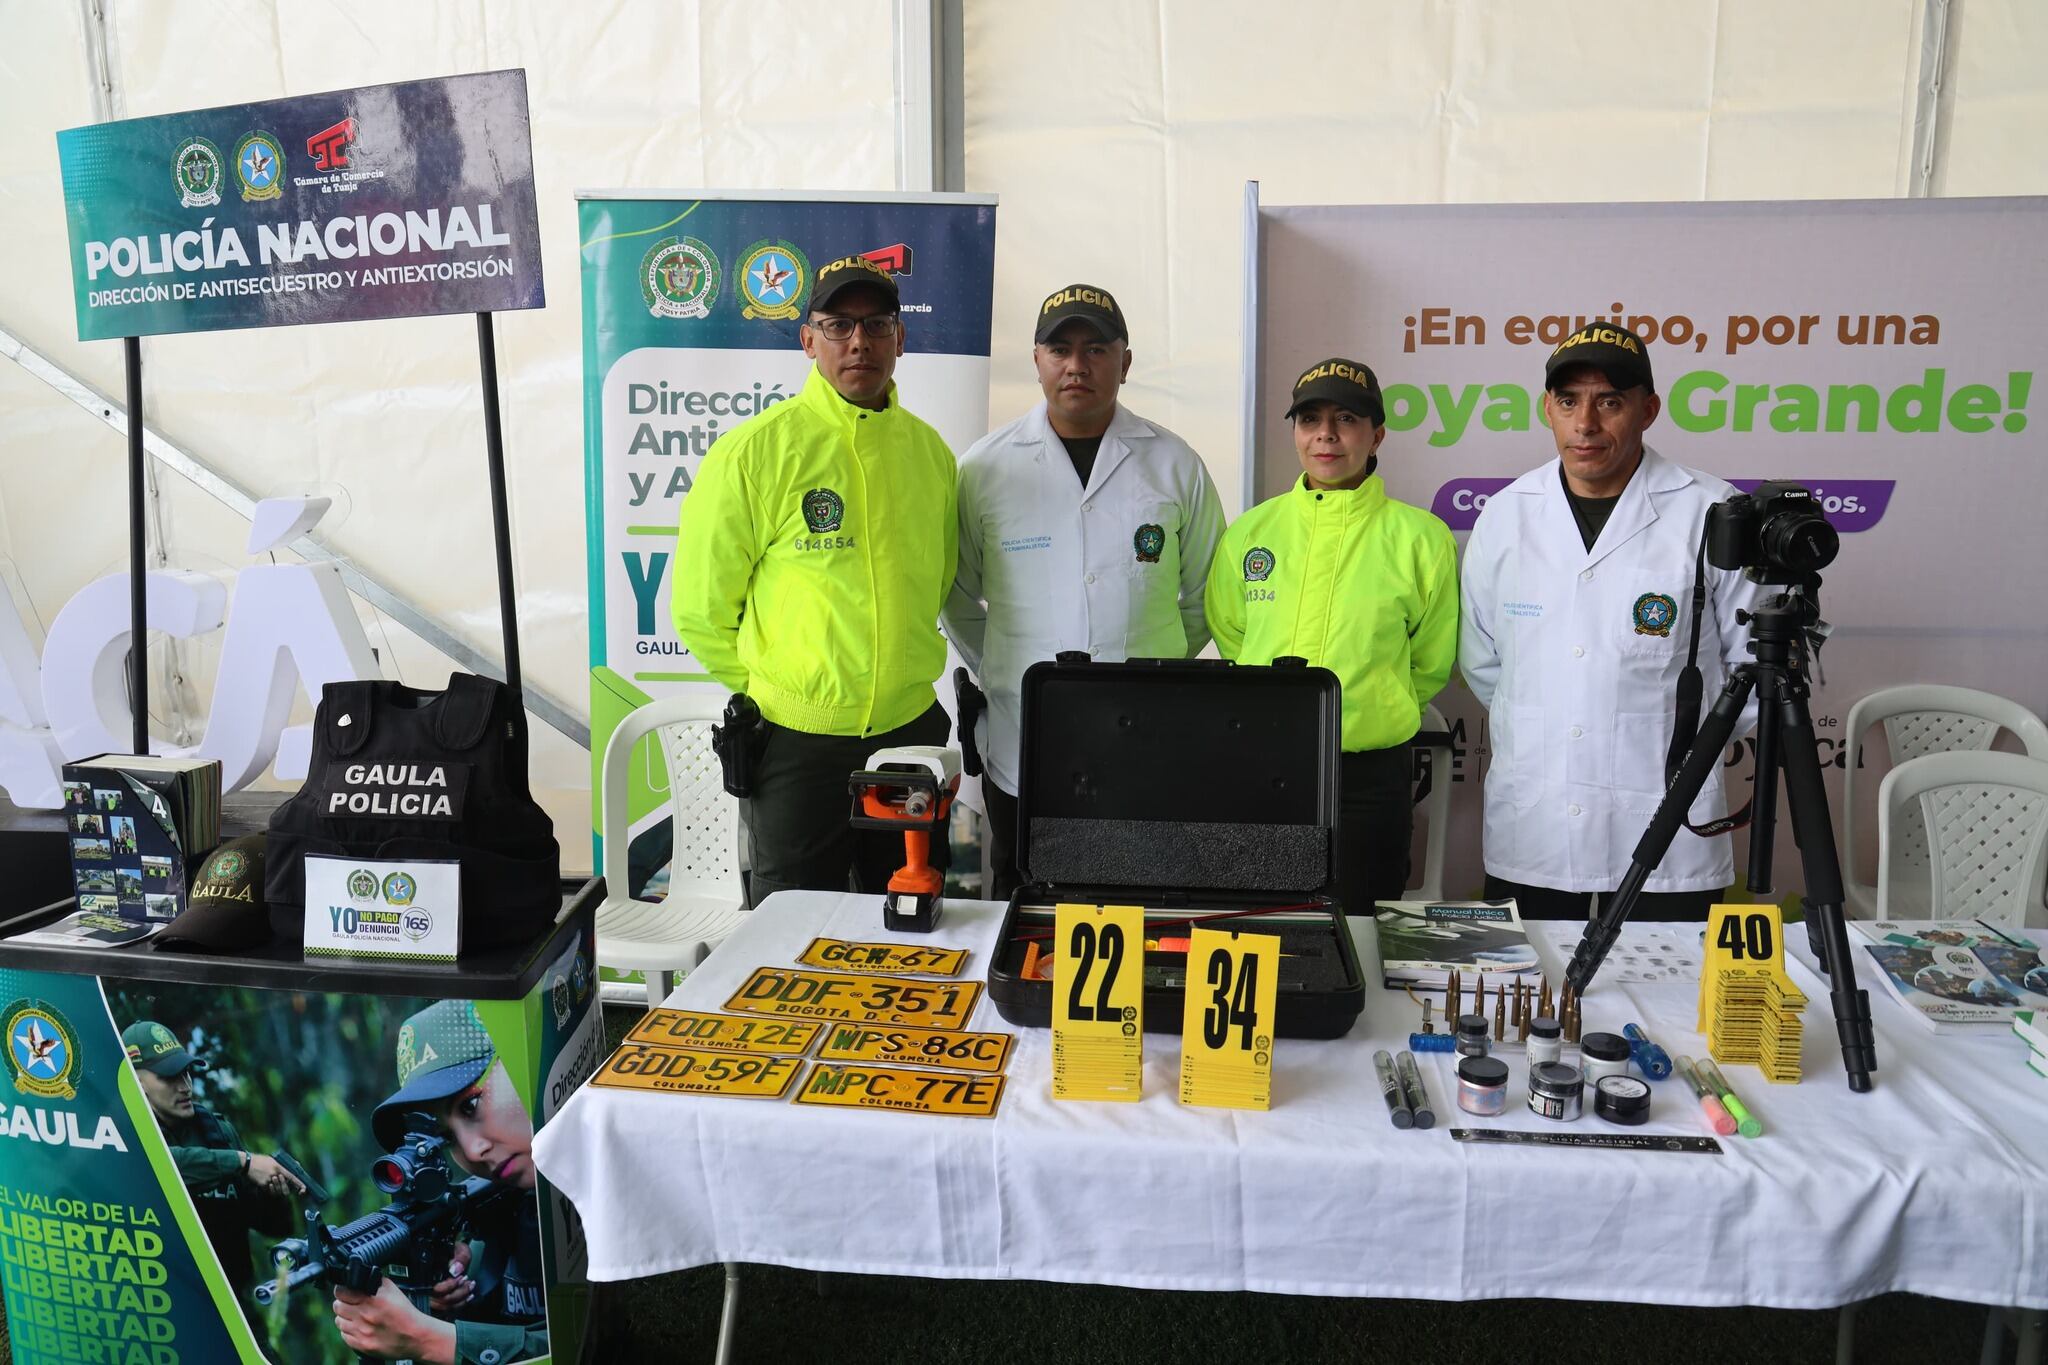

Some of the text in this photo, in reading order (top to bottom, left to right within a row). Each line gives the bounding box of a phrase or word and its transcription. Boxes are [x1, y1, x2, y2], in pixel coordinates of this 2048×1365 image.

[294, 169, 384, 187] Cámara de Comercio
[321, 182, 358, 194] de Tunja
[85, 203, 511, 281] POLICÍA NACIONAL
[88, 254, 514, 308] DIRECCIÓN DE ANTISECUESTRO Y ANTIEXTORSIÓN
[1043, 288, 1114, 315] POLICIA
[1403, 308, 1487, 353] ¡En
[1725, 310, 1821, 354] por
[1836, 313, 1942, 346] una
[1297, 362, 1368, 389] POLICIA
[1667, 368, 2034, 435] Grande!
[628, 472, 657, 507] y
[1784, 491, 1808, 499] Canon
[794, 536, 856, 552] 614854
[1818, 715, 1838, 727] de
[344, 764, 448, 787] GAULA
[328, 792, 453, 816] POLICIA
[192, 880, 255, 902] GAULA
[329, 906, 399, 935] YO NO PAGO
[359, 915, 429, 935] DENUNCIO 165
[1474, 908, 1505, 916] Único
[332, 932, 350, 940] GAULA
[372, 935, 401, 943] NACIONAL
[1717, 914, 1773, 961] 40
[820, 944, 950, 966] GCW 67
[1068, 921, 1125, 1023] 22
[743, 974, 961, 1017] DDF 351
[1203, 948, 1259, 1051] 34
[774, 1003, 851, 1019] BOGOTA
[684, 1038, 749, 1050] COLOMBIA
[732, 1023, 812, 1046] 12E
[831, 1029, 1001, 1061] WPS 86C
[611, 1051, 791, 1083] GDD 59F
[874, 1053, 942, 1065] COLOMBIA
[653, 1080, 722, 1091] COLOMBIA
[808, 1071, 995, 1105] MPC 77E
[859, 1097, 931, 1110] COLOMBIA
[16, 1190, 88, 1220] VALOR
[93, 1202, 125, 1223] DE
[129, 1206, 161, 1227] LA
[0, 1206, 164, 1258] LIBERTAD
[1, 1234, 168, 1287] LIBERTAD
[4, 1262, 173, 1315] LIBERTAD
[9, 1292, 177, 1343] LIBERTAD
[13, 1319, 180, 1365] LIBERTAD
